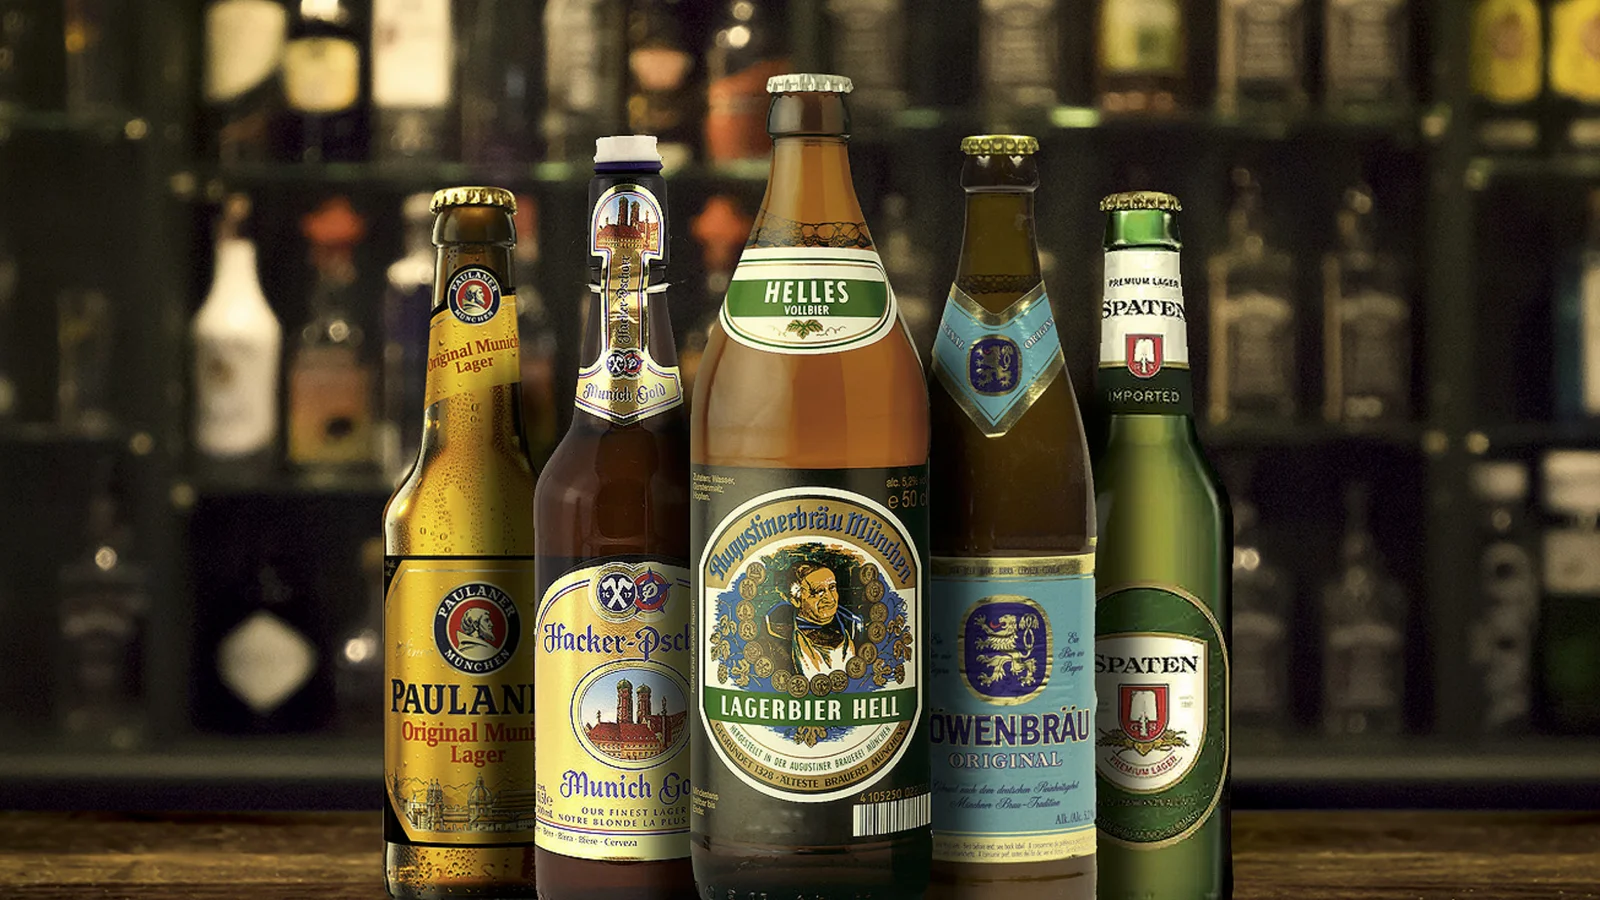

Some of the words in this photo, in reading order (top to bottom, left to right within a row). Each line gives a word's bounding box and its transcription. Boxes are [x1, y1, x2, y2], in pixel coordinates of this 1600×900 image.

[452, 271, 498, 292] PAULANER
[1109, 277, 1149, 287] PREMIUM
[1152, 277, 1179, 288] LAGER
[615, 255, 632, 344] Hacker-Pschorr
[764, 281, 849, 304] HELLES
[784, 305, 830, 315] VOLLBIER
[1102, 299, 1187, 322] SPATEN
[427, 342, 473, 372] Original
[455, 357, 493, 373] Lager
[582, 382, 632, 402] Munich
[635, 382, 666, 405] Gold
[1108, 390, 1180, 402] IMPORTED
[902, 489, 917, 508] 50
[709, 505, 843, 581] Augustinerbräu
[845, 511, 912, 584] München
[437, 584, 517, 618] PAULANER
[1095, 653, 1198, 674] SPATEN
[721, 695, 842, 721] LAGERBIER
[853, 696, 900, 720] HELL
[402, 721, 477, 747] Original
[450, 746, 506, 767] Lager
[715, 723, 754, 769] GEGRÜNDET
[754, 764, 774, 780] 1328
[824, 764, 869, 787] BRAUEREI
[871, 725, 906, 768] MÜNCHENS
[730, 725, 763, 757] HERGESTELLT
[764, 753, 772, 762] IN
[774, 757, 787, 768] DER
[790, 761, 832, 772] AUGUSTINER
[835, 749, 866, 768] BRAUEREI
[949, 751, 1063, 769] ORIGINAL
[1110, 755, 1149, 776] PREMIUM
[1151, 755, 1178, 774] LAGER
[559, 769, 652, 799] Munich
[859, 793, 866, 802] 4
[868, 788, 902, 802] 105250
[558, 813, 588, 825] NOTRE
[593, 818, 638, 827] BLONDE
[643, 818, 656, 827] LA
[661, 816, 687, 826] PLUS
[581, 806, 604, 815] OUR
[609, 807, 649, 816] FINEST
[653, 806, 687, 816] LAGER
[604, 838, 638, 847] Cerveza
